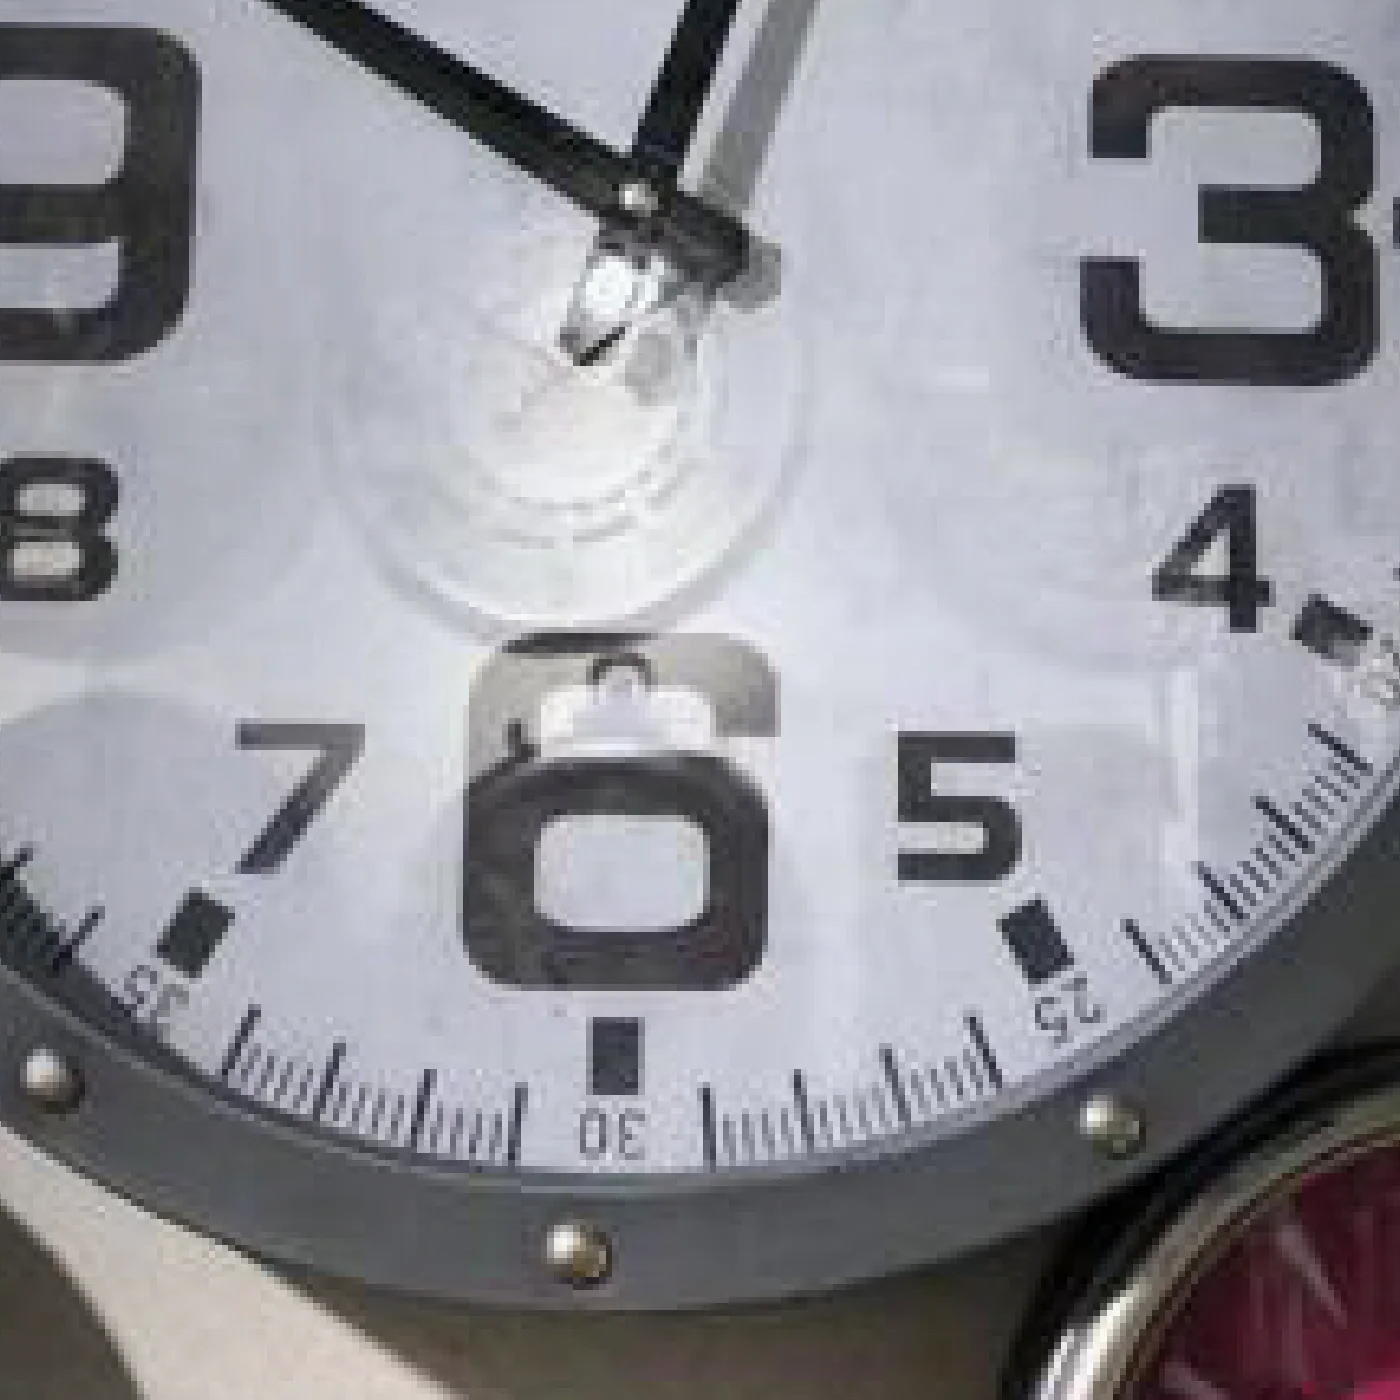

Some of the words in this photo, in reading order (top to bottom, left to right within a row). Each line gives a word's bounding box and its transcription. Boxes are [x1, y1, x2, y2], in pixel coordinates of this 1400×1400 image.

[1080, 54, 1380, 386] 3
[1152, 484, 1270, 633] 4
[235, 722, 366, 876] 7
[456, 629, 781, 991] 6
[898, 729, 1021, 880] 5
[1034, 977, 1103, 1046] 25
[578, 1106, 649, 1161] 30
